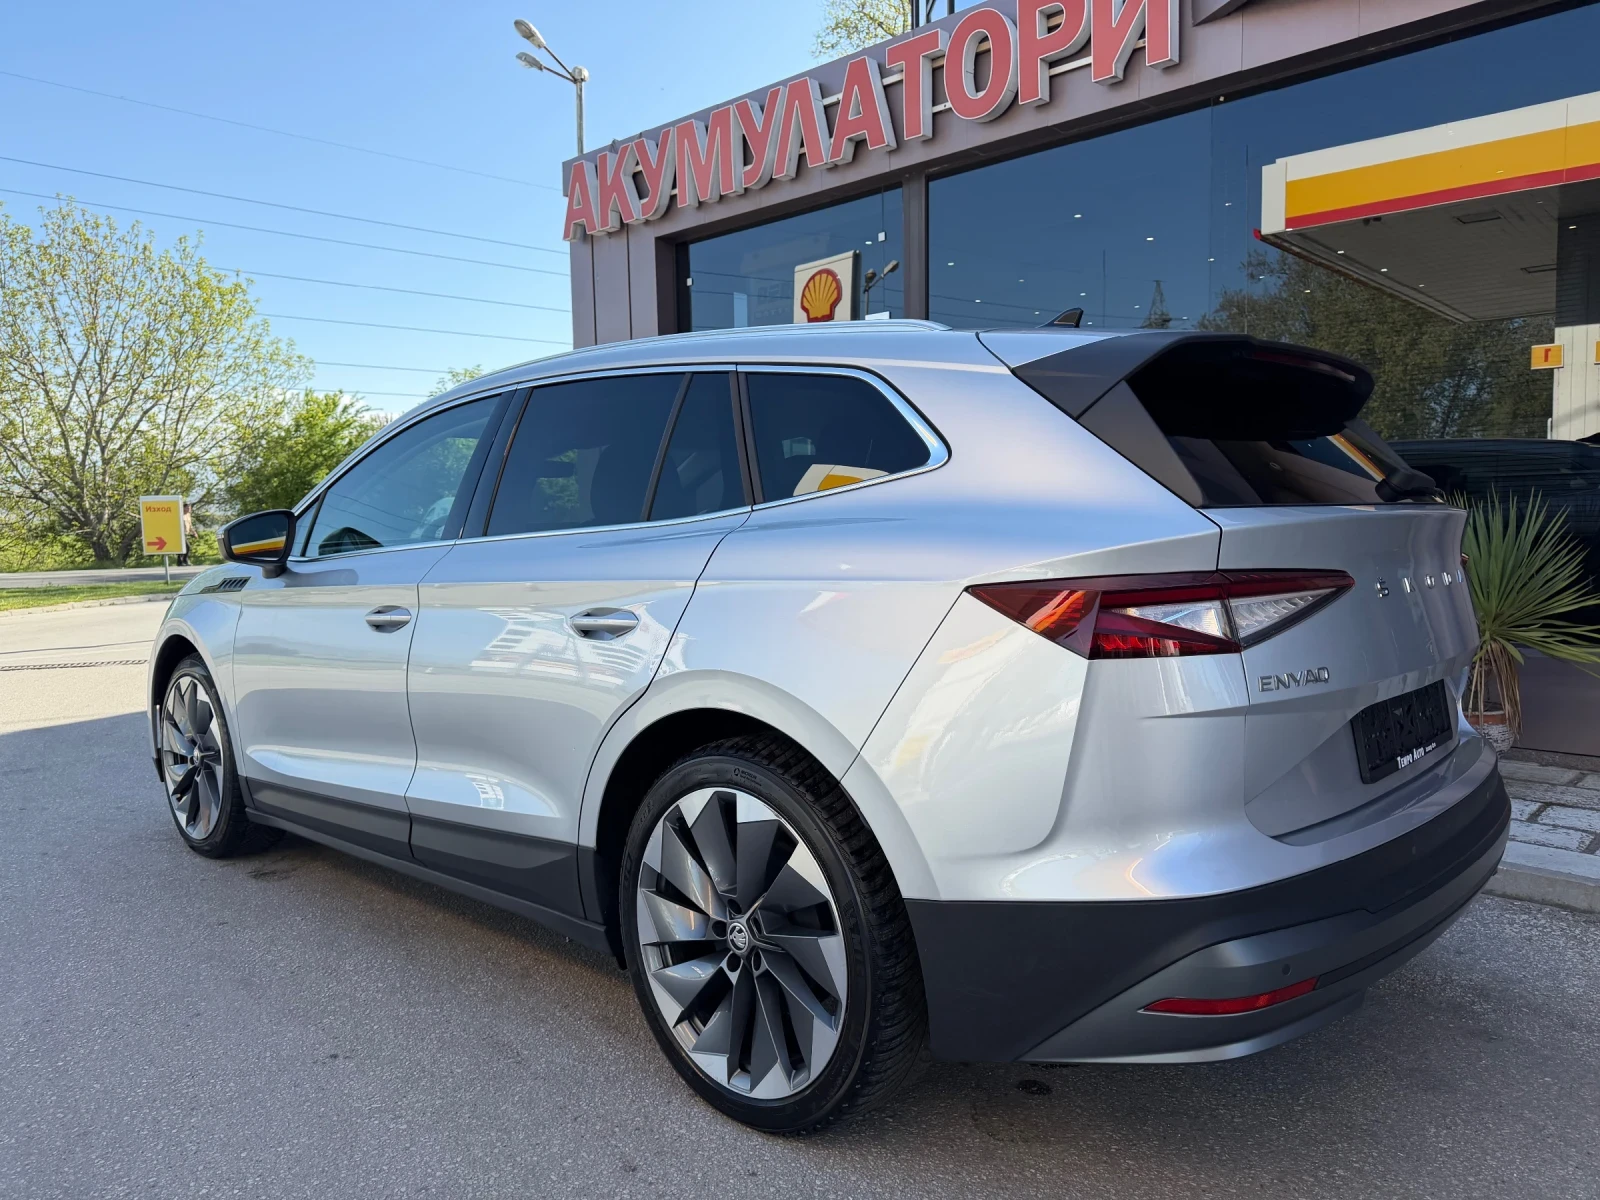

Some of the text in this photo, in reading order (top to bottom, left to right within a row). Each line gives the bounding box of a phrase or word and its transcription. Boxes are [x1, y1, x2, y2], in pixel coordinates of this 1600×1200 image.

[562, 0, 1181, 242] АКУМУЛАТОРИ
[145, 505, 172, 513] Изход
[1257, 666, 1330, 692] ENYAQ
